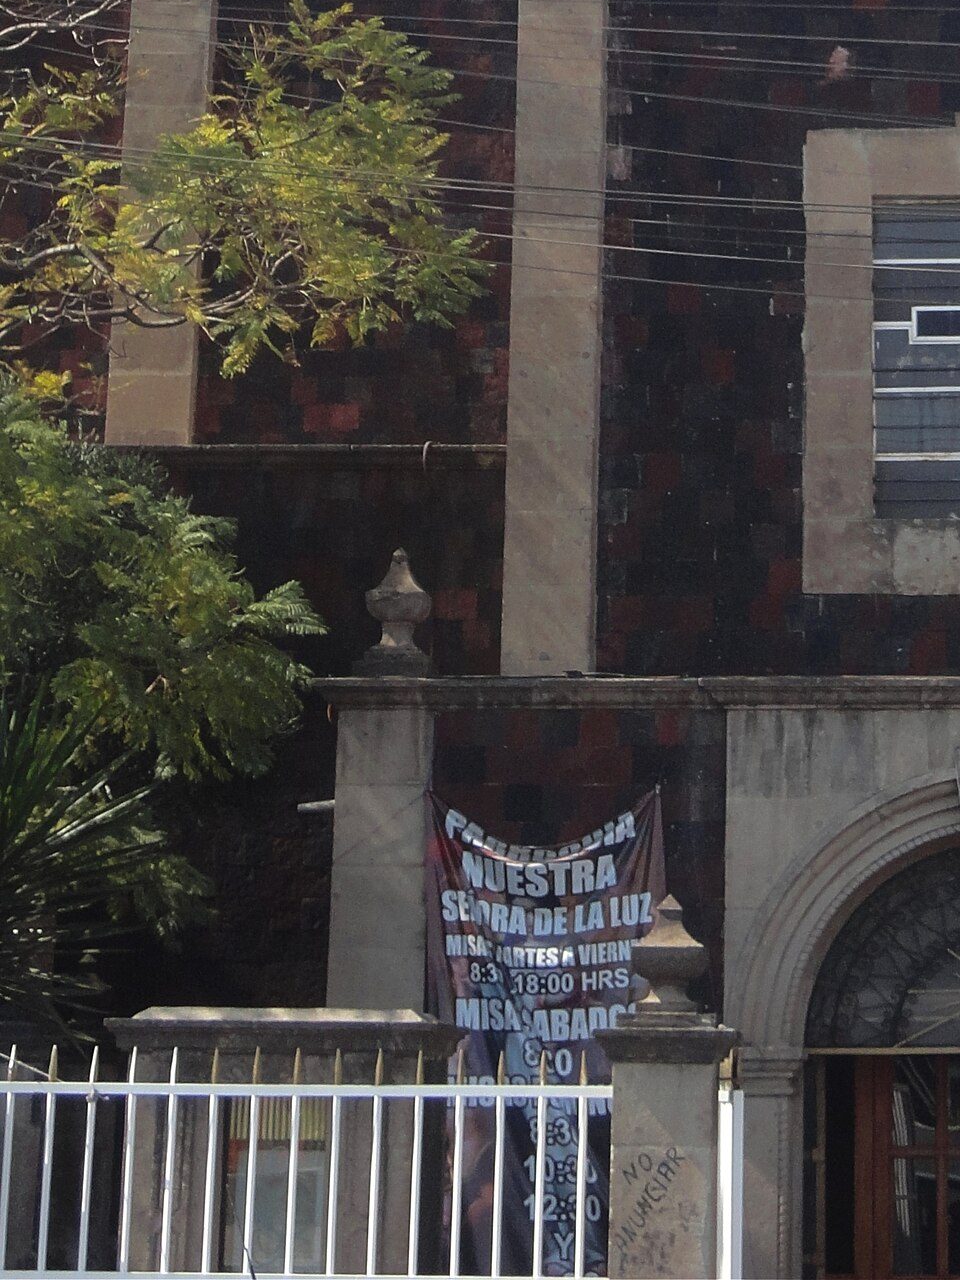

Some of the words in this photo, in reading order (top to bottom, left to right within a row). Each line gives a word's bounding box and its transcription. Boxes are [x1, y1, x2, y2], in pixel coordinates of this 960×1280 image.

[461, 850, 618, 898] NUESTRA
[533, 906, 568, 937] DE
[574, 900, 606, 934] LA
[609, 891, 653, 928] LUZ
[578, 939, 637, 966] VIERN
[581, 967, 630, 992] HRS
[622, 1152, 653, 1186] NO
[616, 1147, 686, 1251] ANUNCIAR
[553, 1232, 574, 1260] Y
